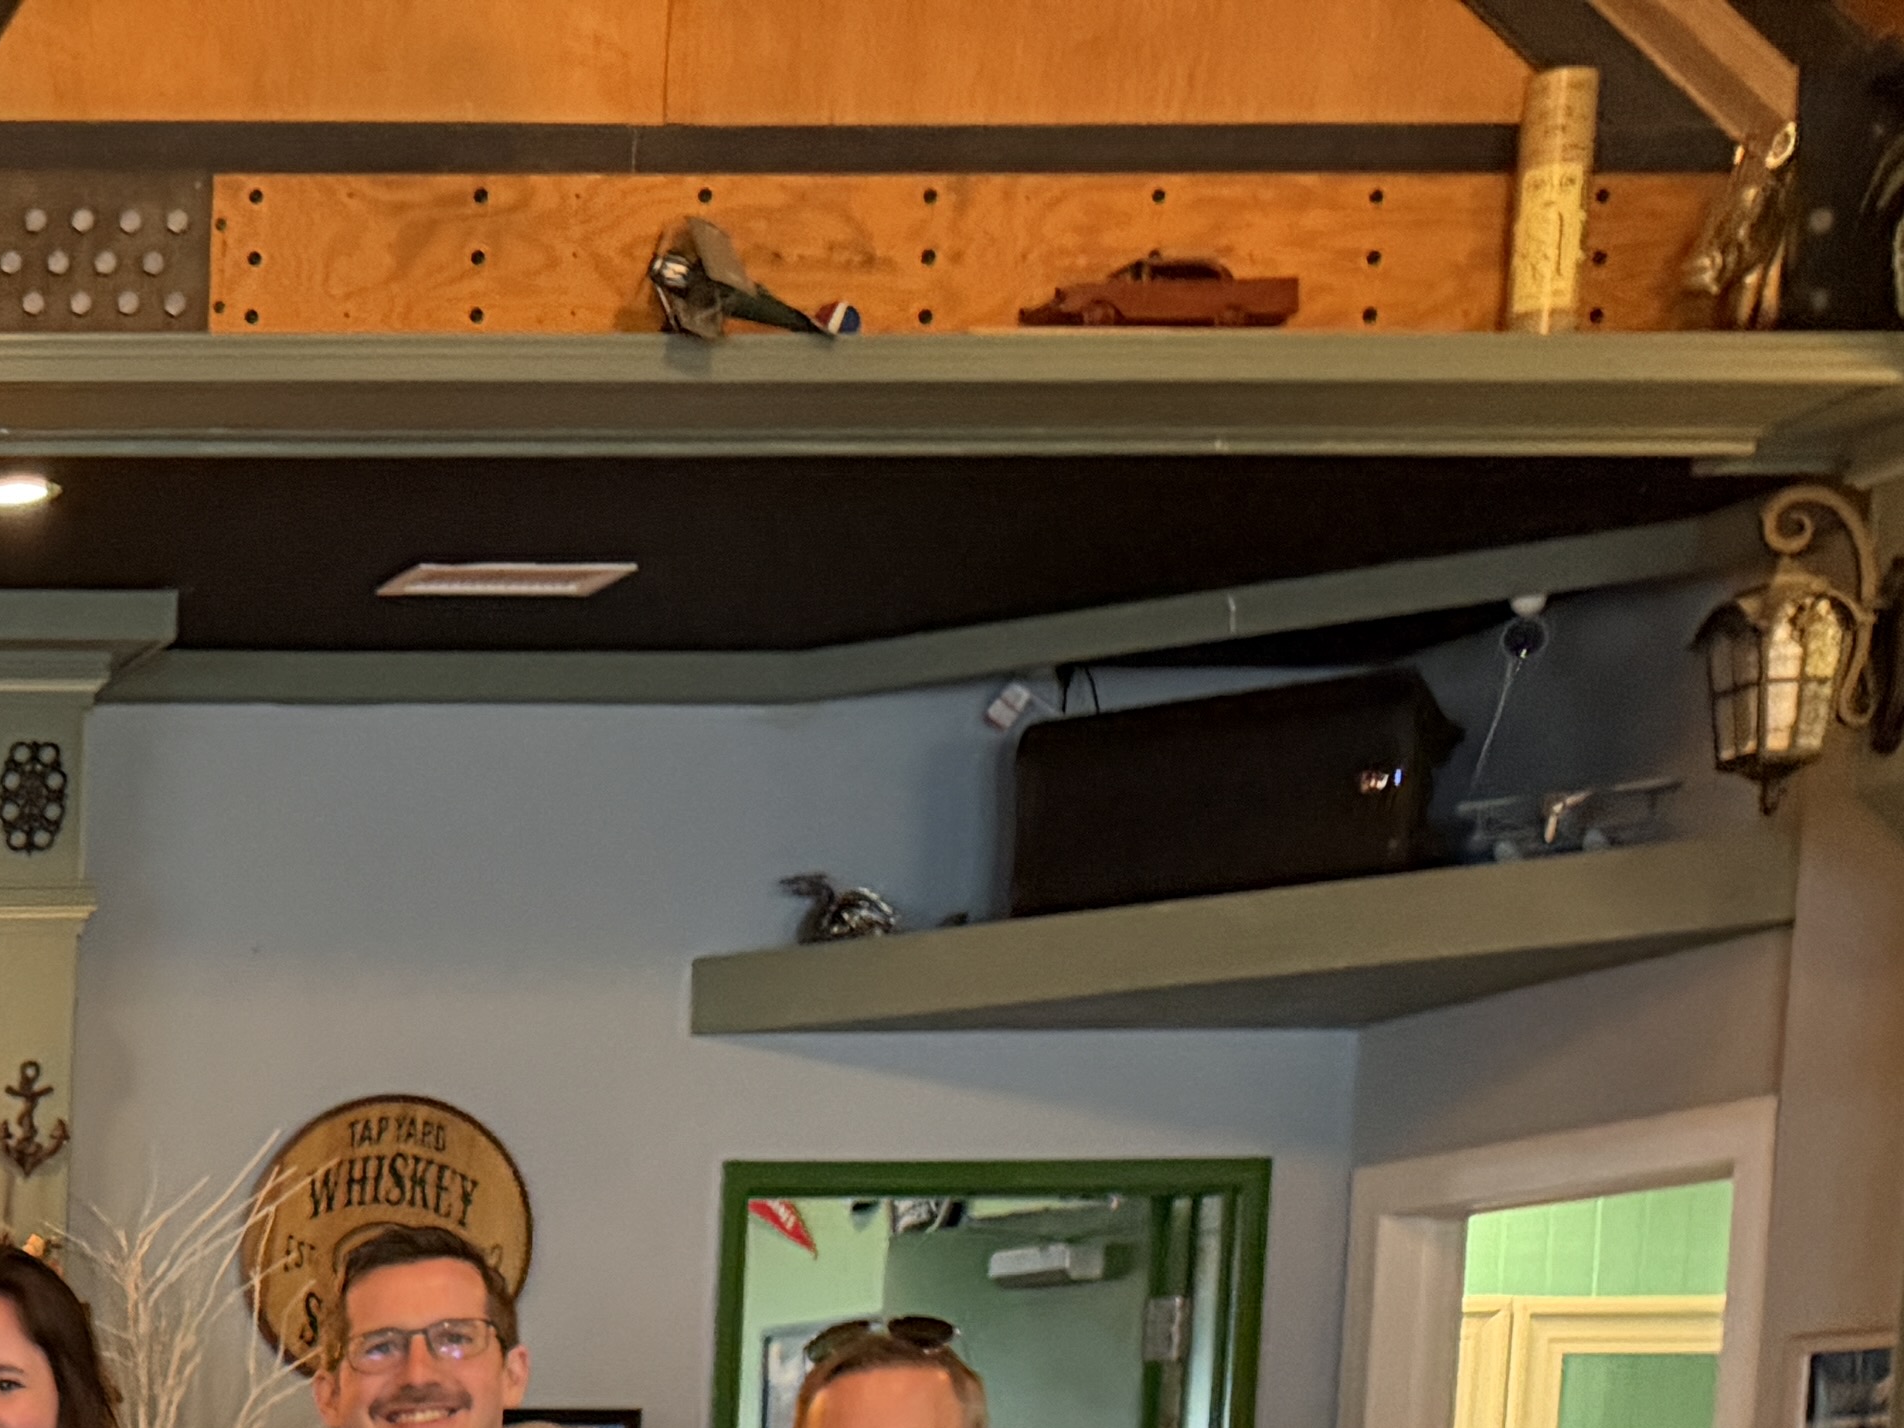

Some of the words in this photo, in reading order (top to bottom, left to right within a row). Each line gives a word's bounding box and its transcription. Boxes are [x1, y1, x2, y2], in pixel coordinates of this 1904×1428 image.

[348, 1116, 391, 1150] TAP
[393, 1115, 448, 1152] YARD
[307, 1151, 480, 1228] WHISKEY
